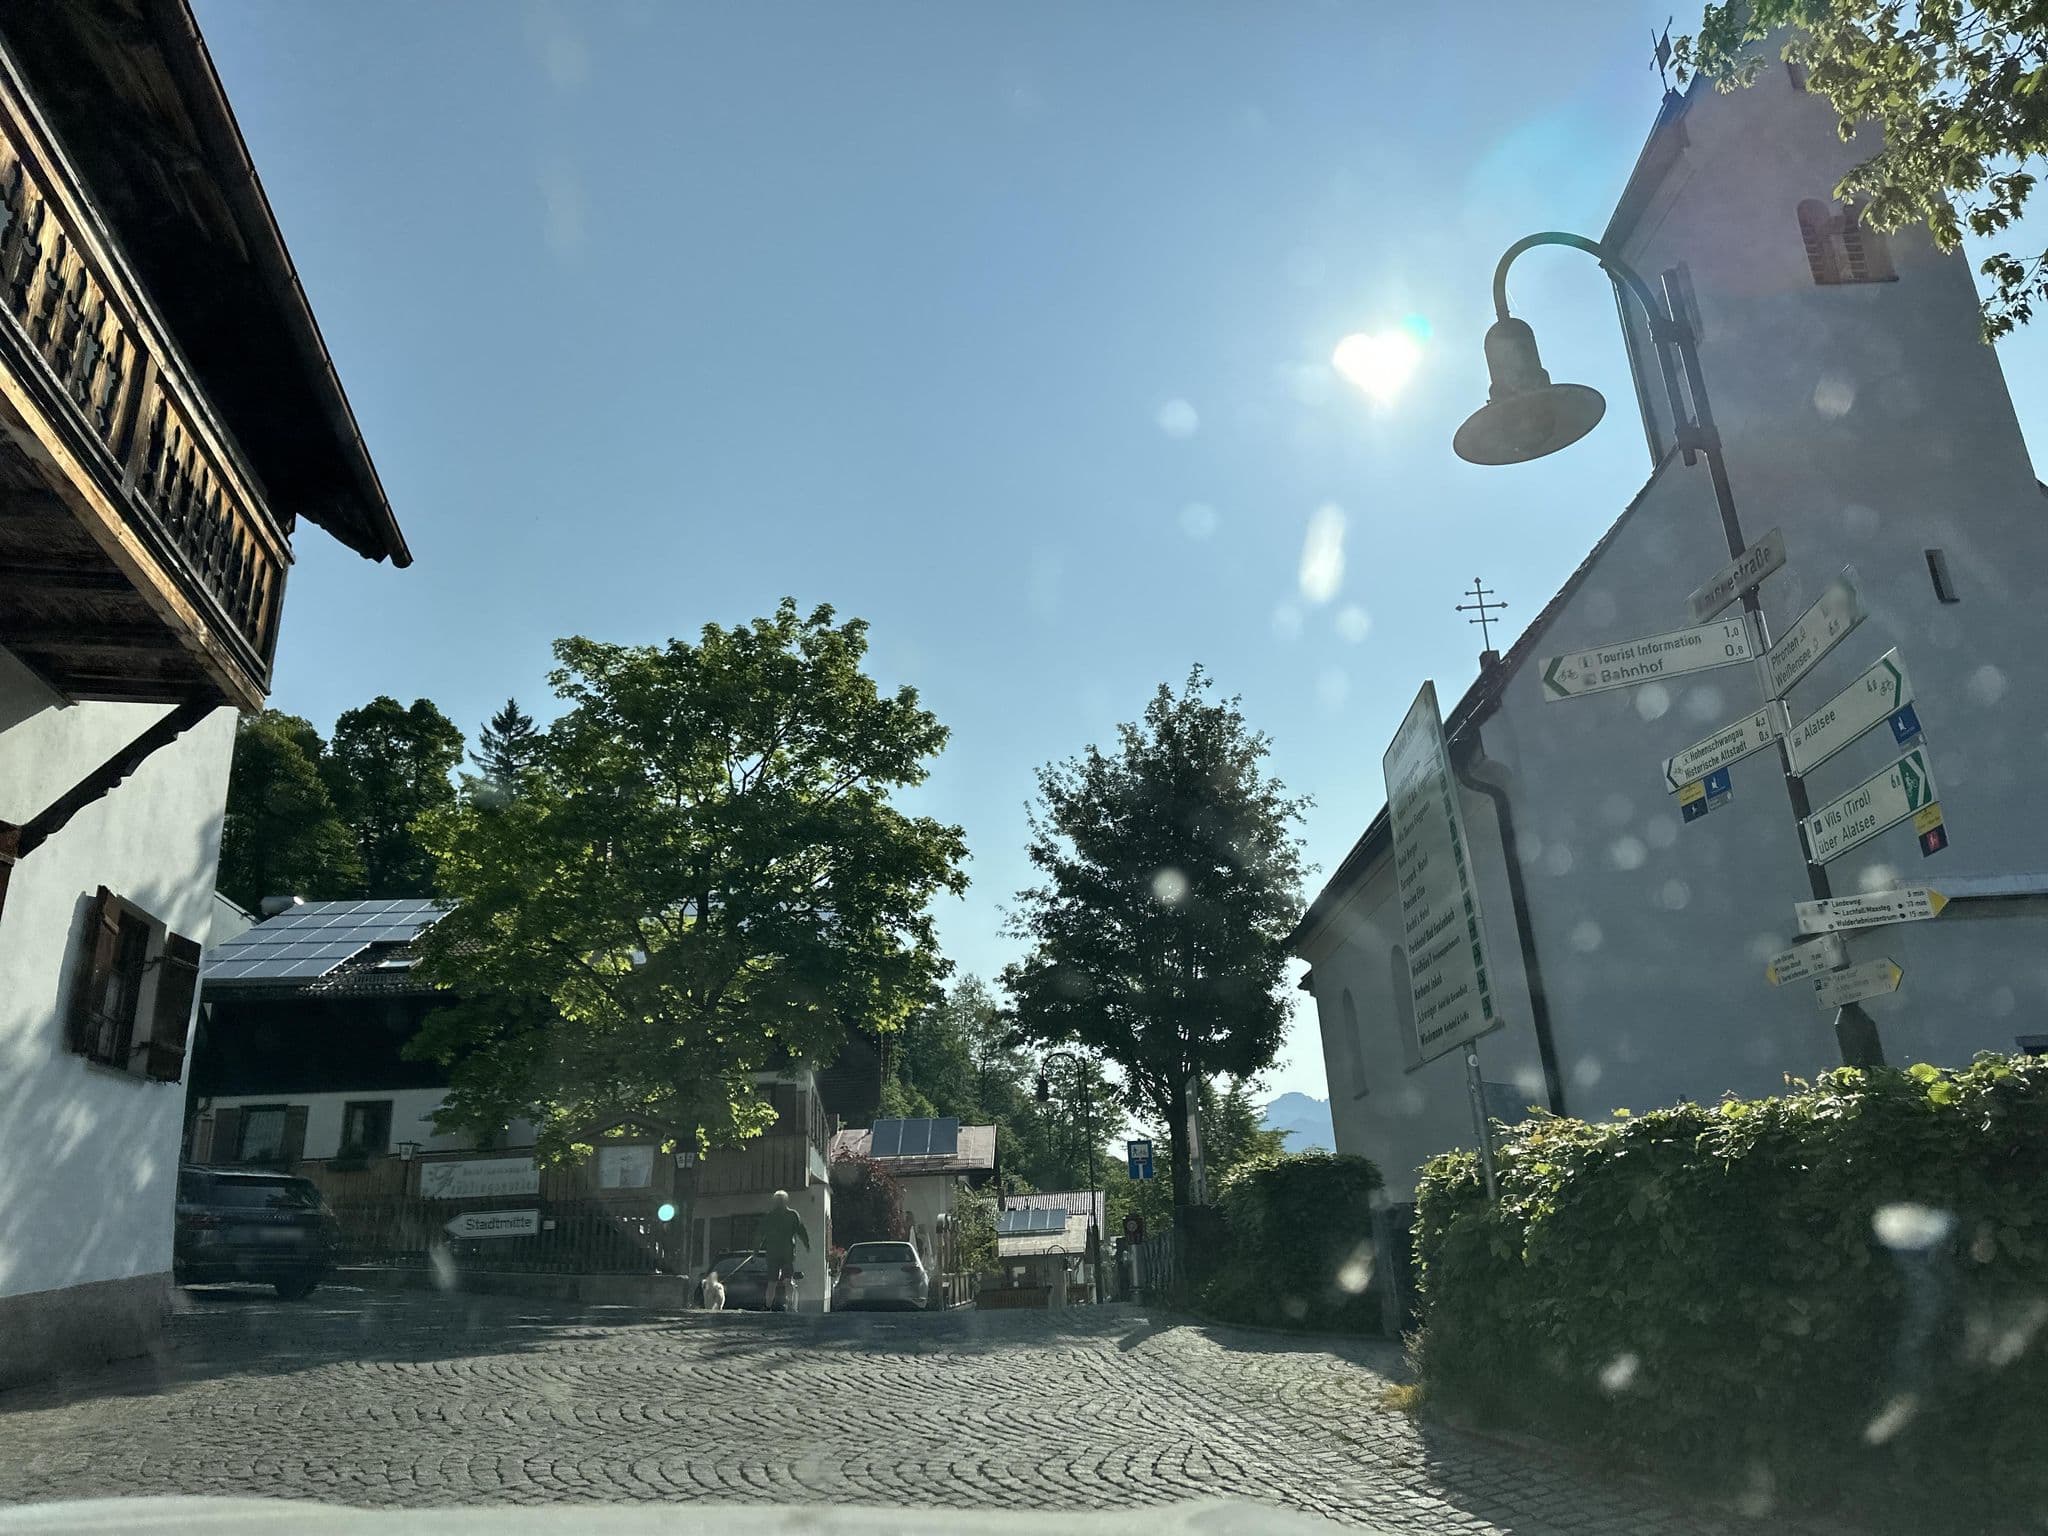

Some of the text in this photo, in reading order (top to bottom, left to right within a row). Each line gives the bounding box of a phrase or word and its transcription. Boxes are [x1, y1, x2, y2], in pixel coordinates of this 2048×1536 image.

[1596, 647, 1636, 664] Tourist
[1637, 635, 1702, 656] Information
[1600, 658, 1663, 683] Bahnhof
[1774, 649, 1811, 687] Weißensee
[1804, 710, 1836, 740] Alatsee
[1685, 755, 1719, 779] Historische
[1720, 741, 1748, 761] Altstadt
[1690, 728, 1744, 761] Hohenschwangau
[1824, 811, 1841, 828] Vils
[1843, 789, 1871, 818] (Tirol)
[1819, 814, 1875, 854] über Alatsee
[465, 1215, 532, 1231] Stadtmitte
